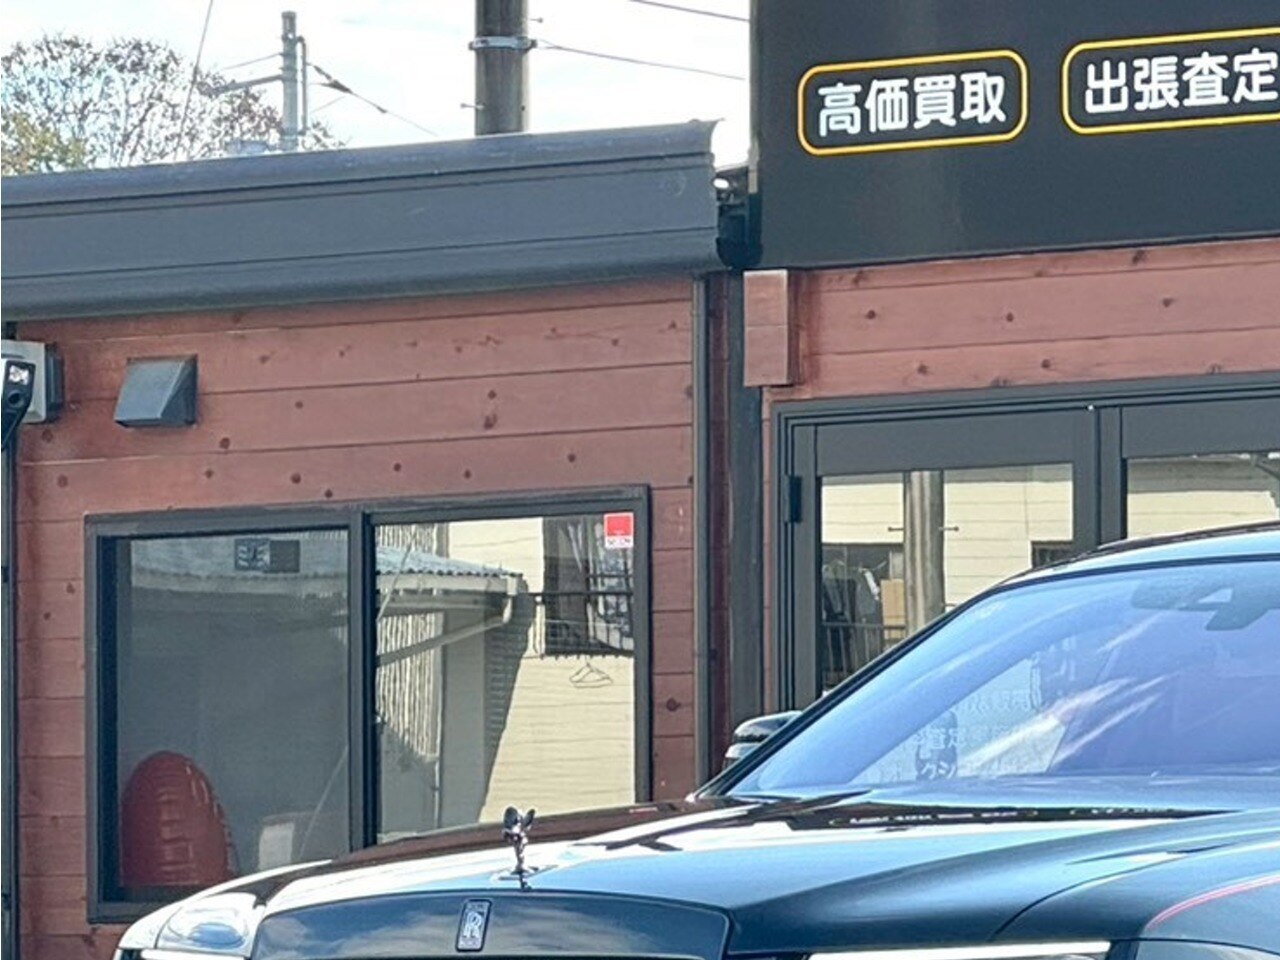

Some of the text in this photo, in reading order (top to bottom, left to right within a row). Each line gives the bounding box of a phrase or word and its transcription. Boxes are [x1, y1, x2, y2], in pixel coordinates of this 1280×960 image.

[818, 72, 1006, 138] 高価買取
[1084, 48, 1279, 114] 出張査定
